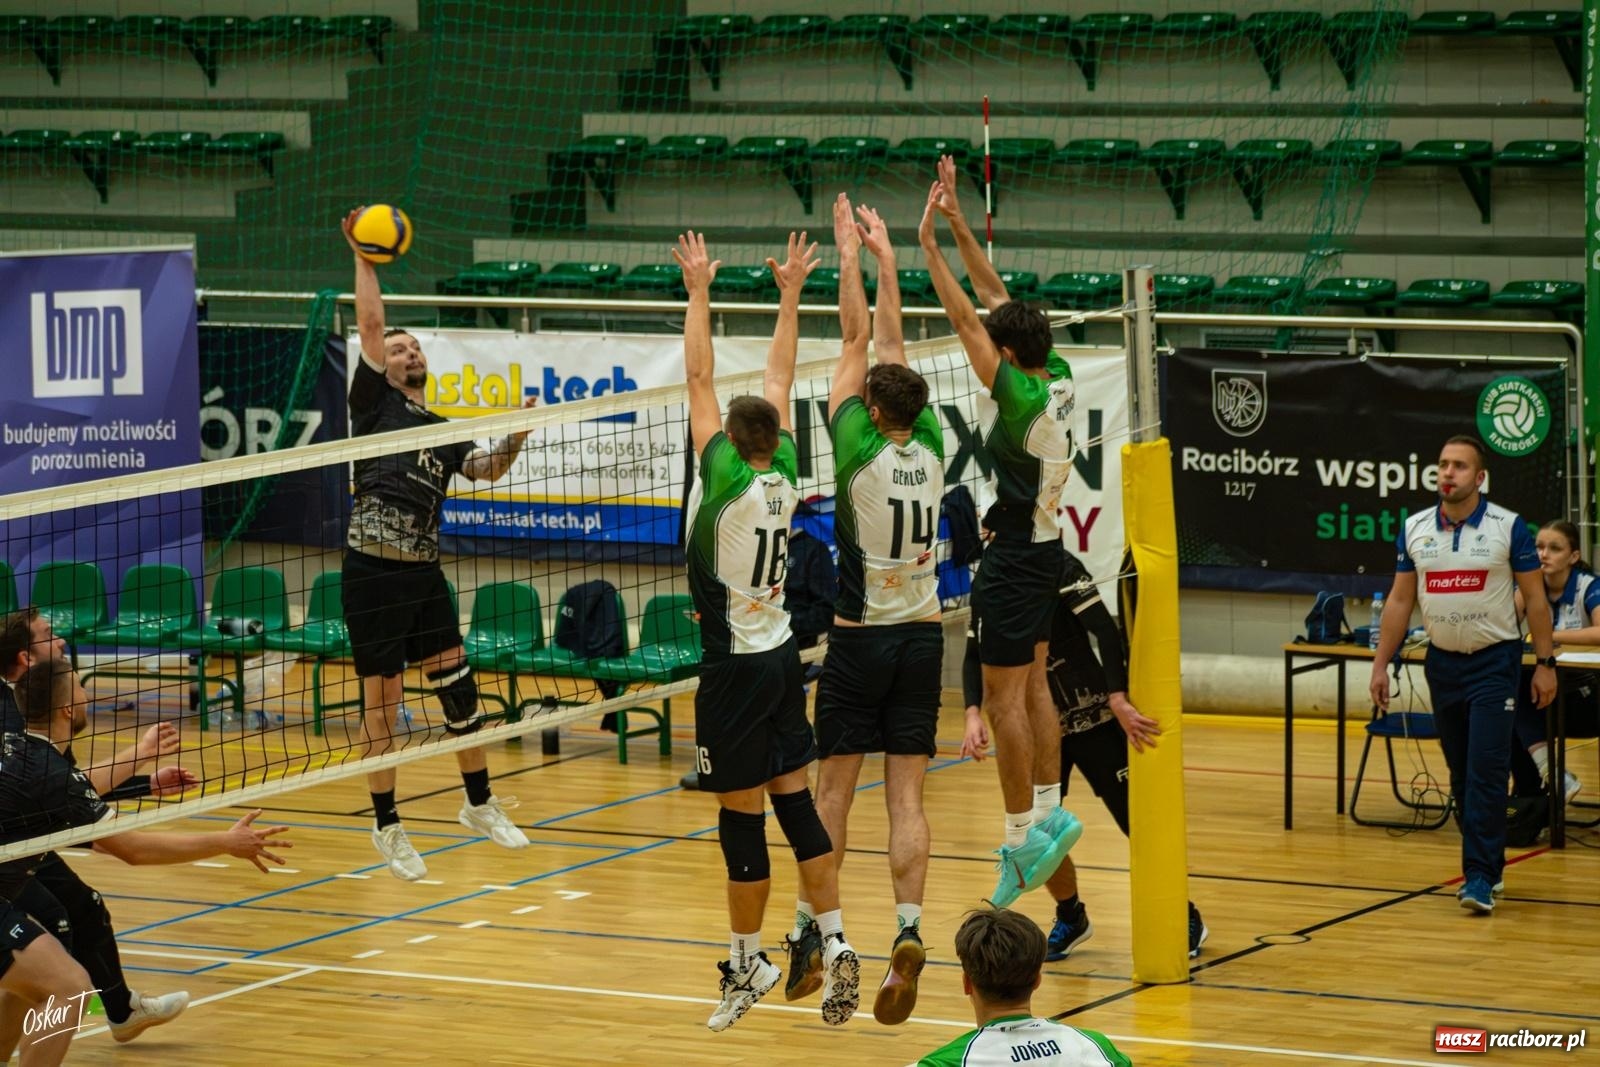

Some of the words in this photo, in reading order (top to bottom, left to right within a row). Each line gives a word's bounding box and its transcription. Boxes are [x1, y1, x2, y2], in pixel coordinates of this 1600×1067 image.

[31, 289, 144, 398] bmp
[425, 363, 638, 407] nstal-tech
[1482, 388, 1499, 414] KLUB
[1498, 381, 1545, 417] SIATKARSKI
[4, 422, 78, 447] budujemy
[83, 419, 177, 441] możliwości
[31, 448, 146, 474] porozumienia
[531, 465, 557, 477] von
[660, 467, 668, 480] 2
[1182, 447, 1299, 476] Racibórz
[1224, 481, 1256, 501] 1217
[443, 507, 602, 535] www.instal-tech.pl
[887, 497, 934, 560] 14
[750, 526, 788, 589] 16
[1010, 1040, 1062, 1063] JOŃCA
